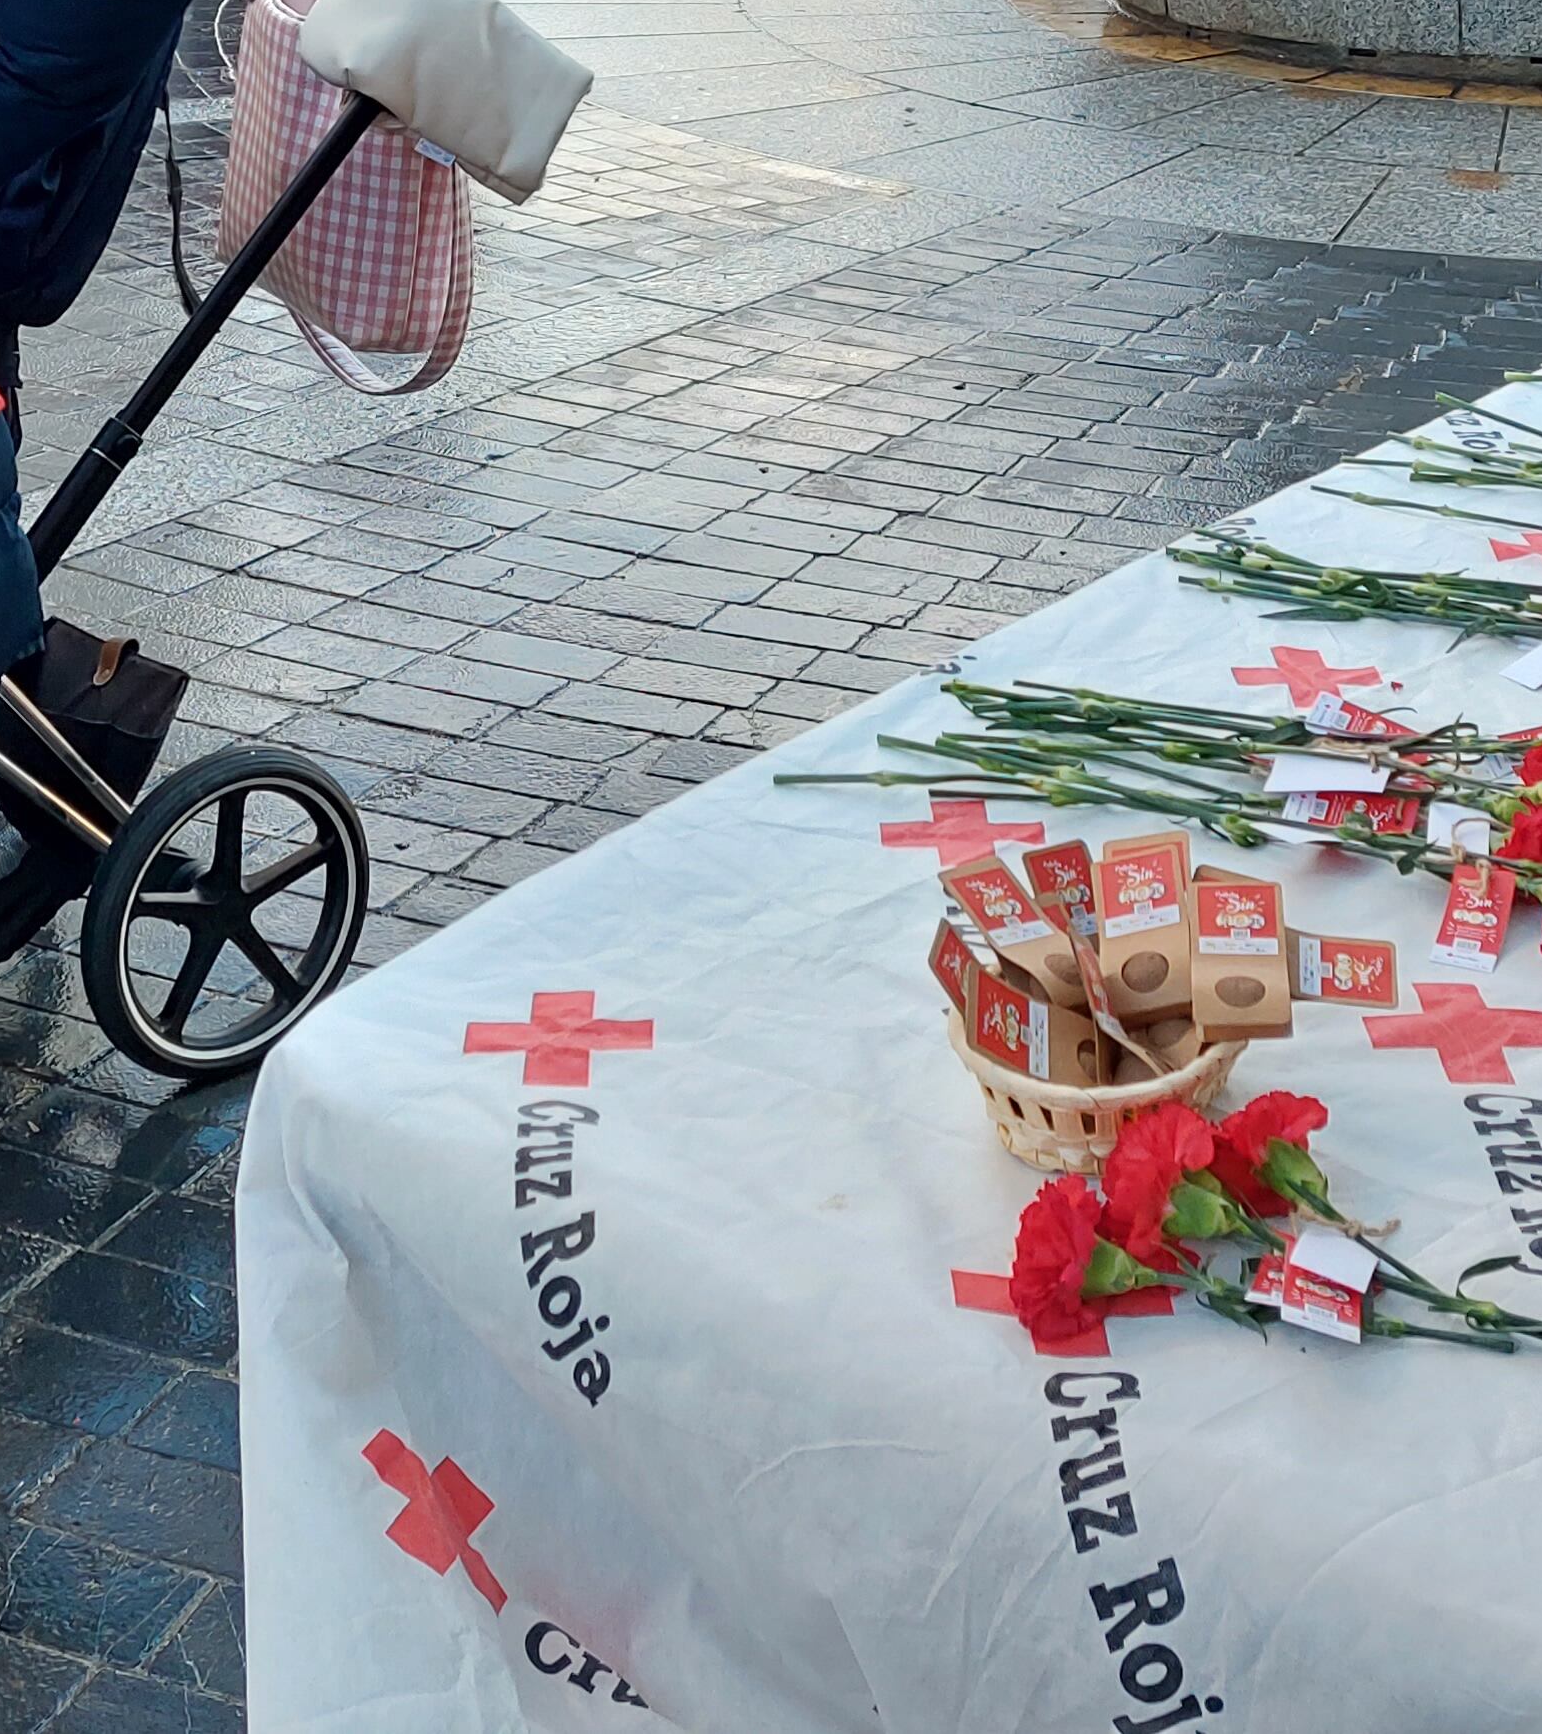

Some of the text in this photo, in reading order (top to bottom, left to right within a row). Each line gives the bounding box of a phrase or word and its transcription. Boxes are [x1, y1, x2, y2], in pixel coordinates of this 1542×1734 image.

[514, 1100, 611, 1409] Cruz Roja
[524, 1621, 650, 1709] Cru
[1044, 1371, 1224, 1734] Cruz Roj
